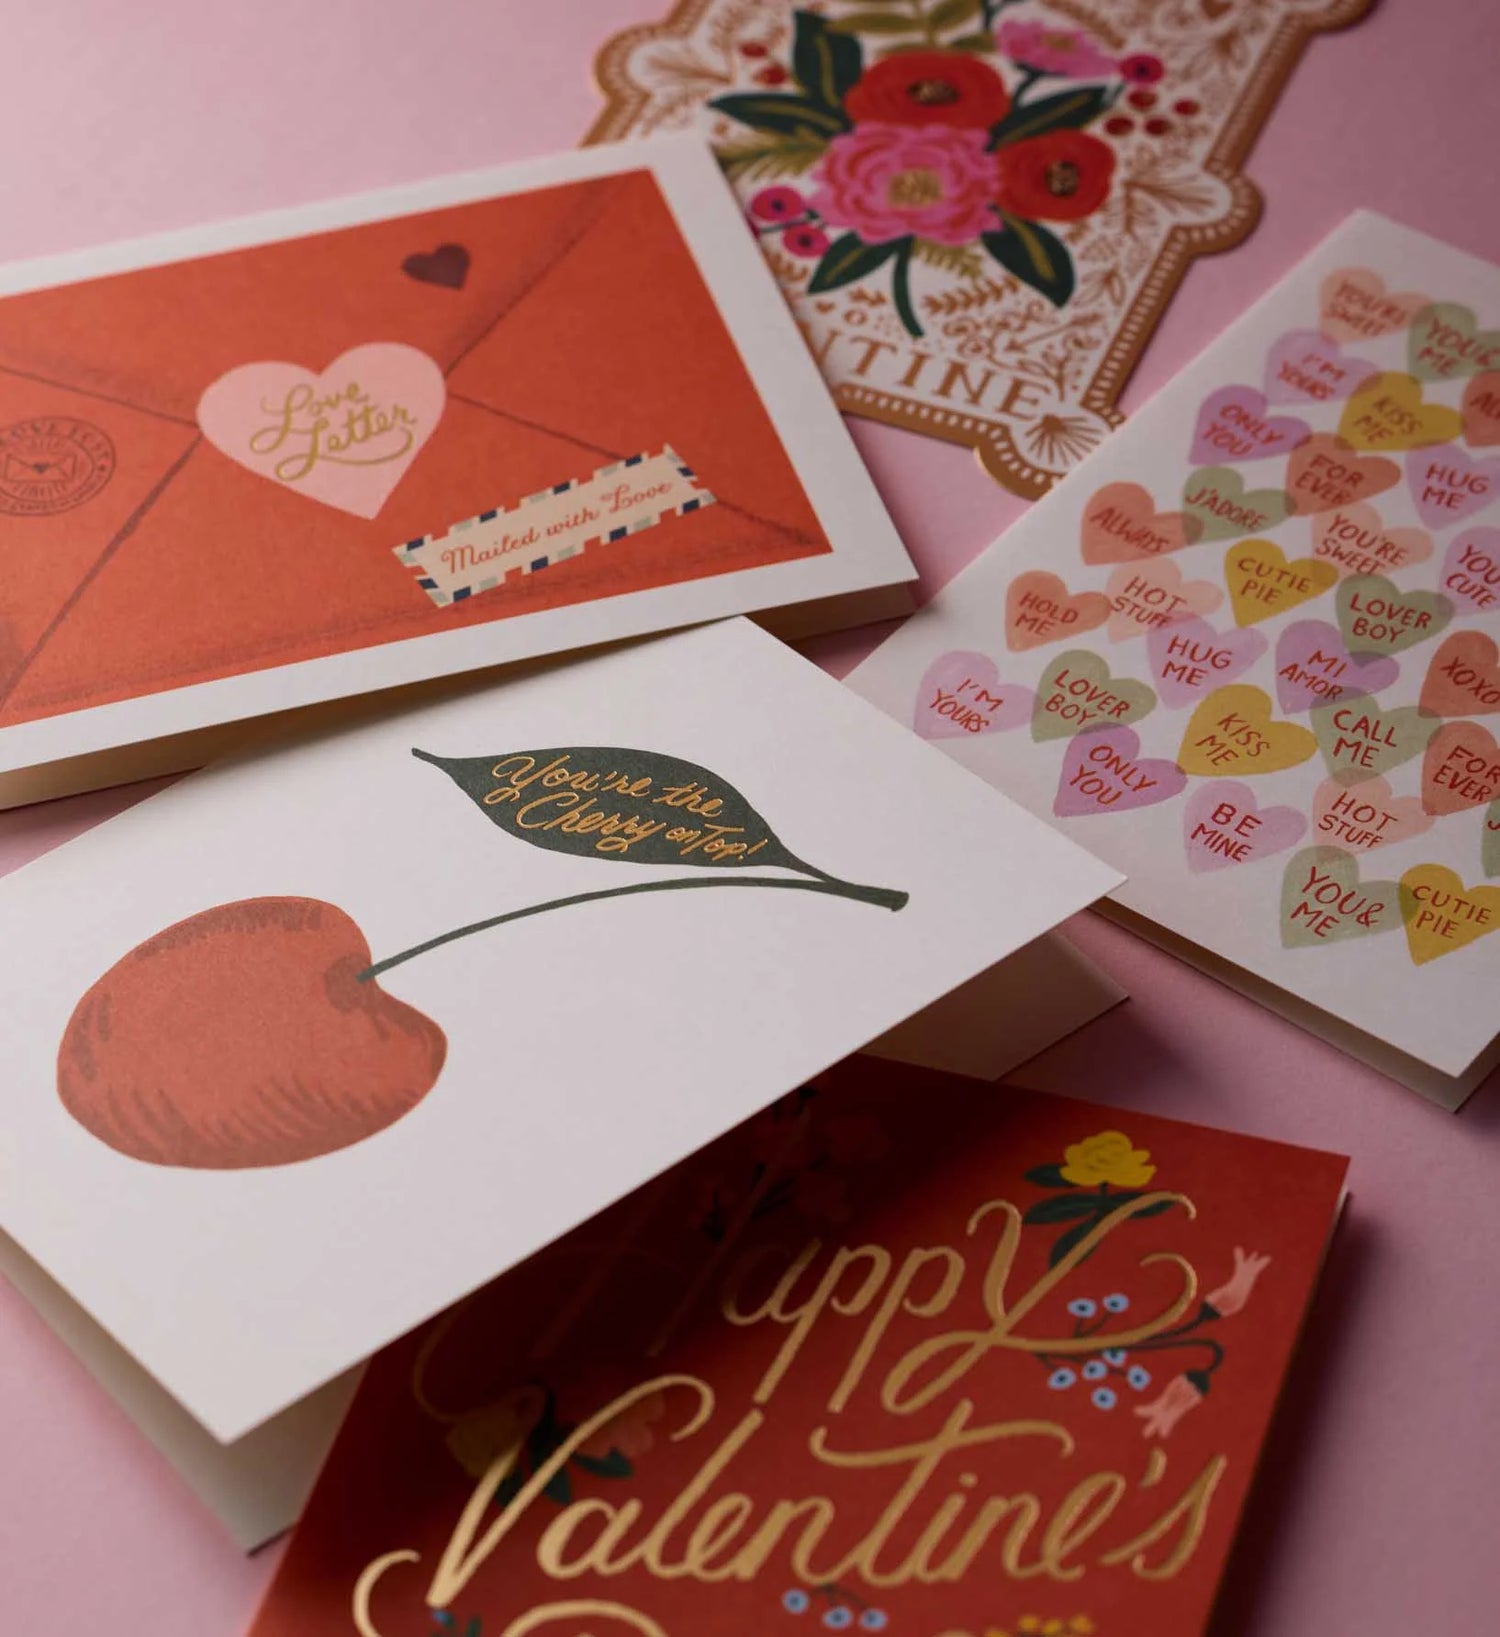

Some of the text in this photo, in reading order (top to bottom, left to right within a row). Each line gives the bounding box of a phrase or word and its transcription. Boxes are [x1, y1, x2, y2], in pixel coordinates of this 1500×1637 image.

[1301, 353, 1347, 382] I'M
[250, 383, 368, 454] Love
[1219, 404, 1283, 444] ONLY
[1353, 415, 1394, 442] ME
[1372, 396, 1423, 436] KISS
[274, 404, 417, 481] Letter
[1203, 422, 1253, 456] YOU
[1295, 471, 1351, 505] EVER
[1309, 454, 1365, 489] FOR
[1426, 463, 1490, 495] HUG
[1185, 488, 1268, 531] J'ADORE
[1421, 486, 1465, 509] ME
[441, 483, 673, 573] Mailed with Love
[1089, 506, 1171, 554] ALWAYS
[1323, 514, 1409, 567] YOU'RE
[1315, 537, 1389, 576] SWEET
[1238, 557, 1313, 594] CUTIE
[1241, 580, 1284, 606] PIE
[1446, 572, 1498, 608] CUTE
[1019, 594, 1079, 625] HOLD
[1110, 597, 1175, 629] STUFF
[1124, 577, 1188, 613] HOT
[1349, 593, 1433, 630] LOVER
[1015, 613, 1056, 636] ME
[1353, 616, 1405, 644] BOY
[1167, 636, 1232, 670] HUG
[1308, 650, 1348, 678] MI
[1162, 661, 1209, 688] ME
[1278, 663, 1344, 700] AMOR
[1440, 656, 1500, 705] XOXO
[929, 688, 990, 734] YOURS
[957, 678, 1004, 713] I'M
[1045, 697, 1100, 728] BOY
[1054, 669, 1131, 719] LOVER
[1217, 712, 1271, 757] KISS
[1332, 709, 1398, 747] CALL
[1089, 745, 1157, 792] ONLY
[1195, 734, 1240, 767] ME
[1333, 737, 1380, 769] ME
[1447, 745, 1500, 785] FOR
[484, 755, 723, 818] You're the
[1068, 764, 1124, 807] YOU
[1432, 764, 1492, 802] EVER
[516, 792, 666, 853] Cherry
[1210, 802, 1263, 838] BE
[1331, 791, 1399, 831] HOT
[1190, 822, 1254, 863] MINE
[1317, 814, 1384, 849] STUFF
[1302, 865, 1385, 928] YOU&
[1412, 885, 1492, 925] CUTIE
[1290, 900, 1341, 938] ME
[1415, 911, 1460, 940] PIE
[426, 1374, 1228, 1608] Valentine's
